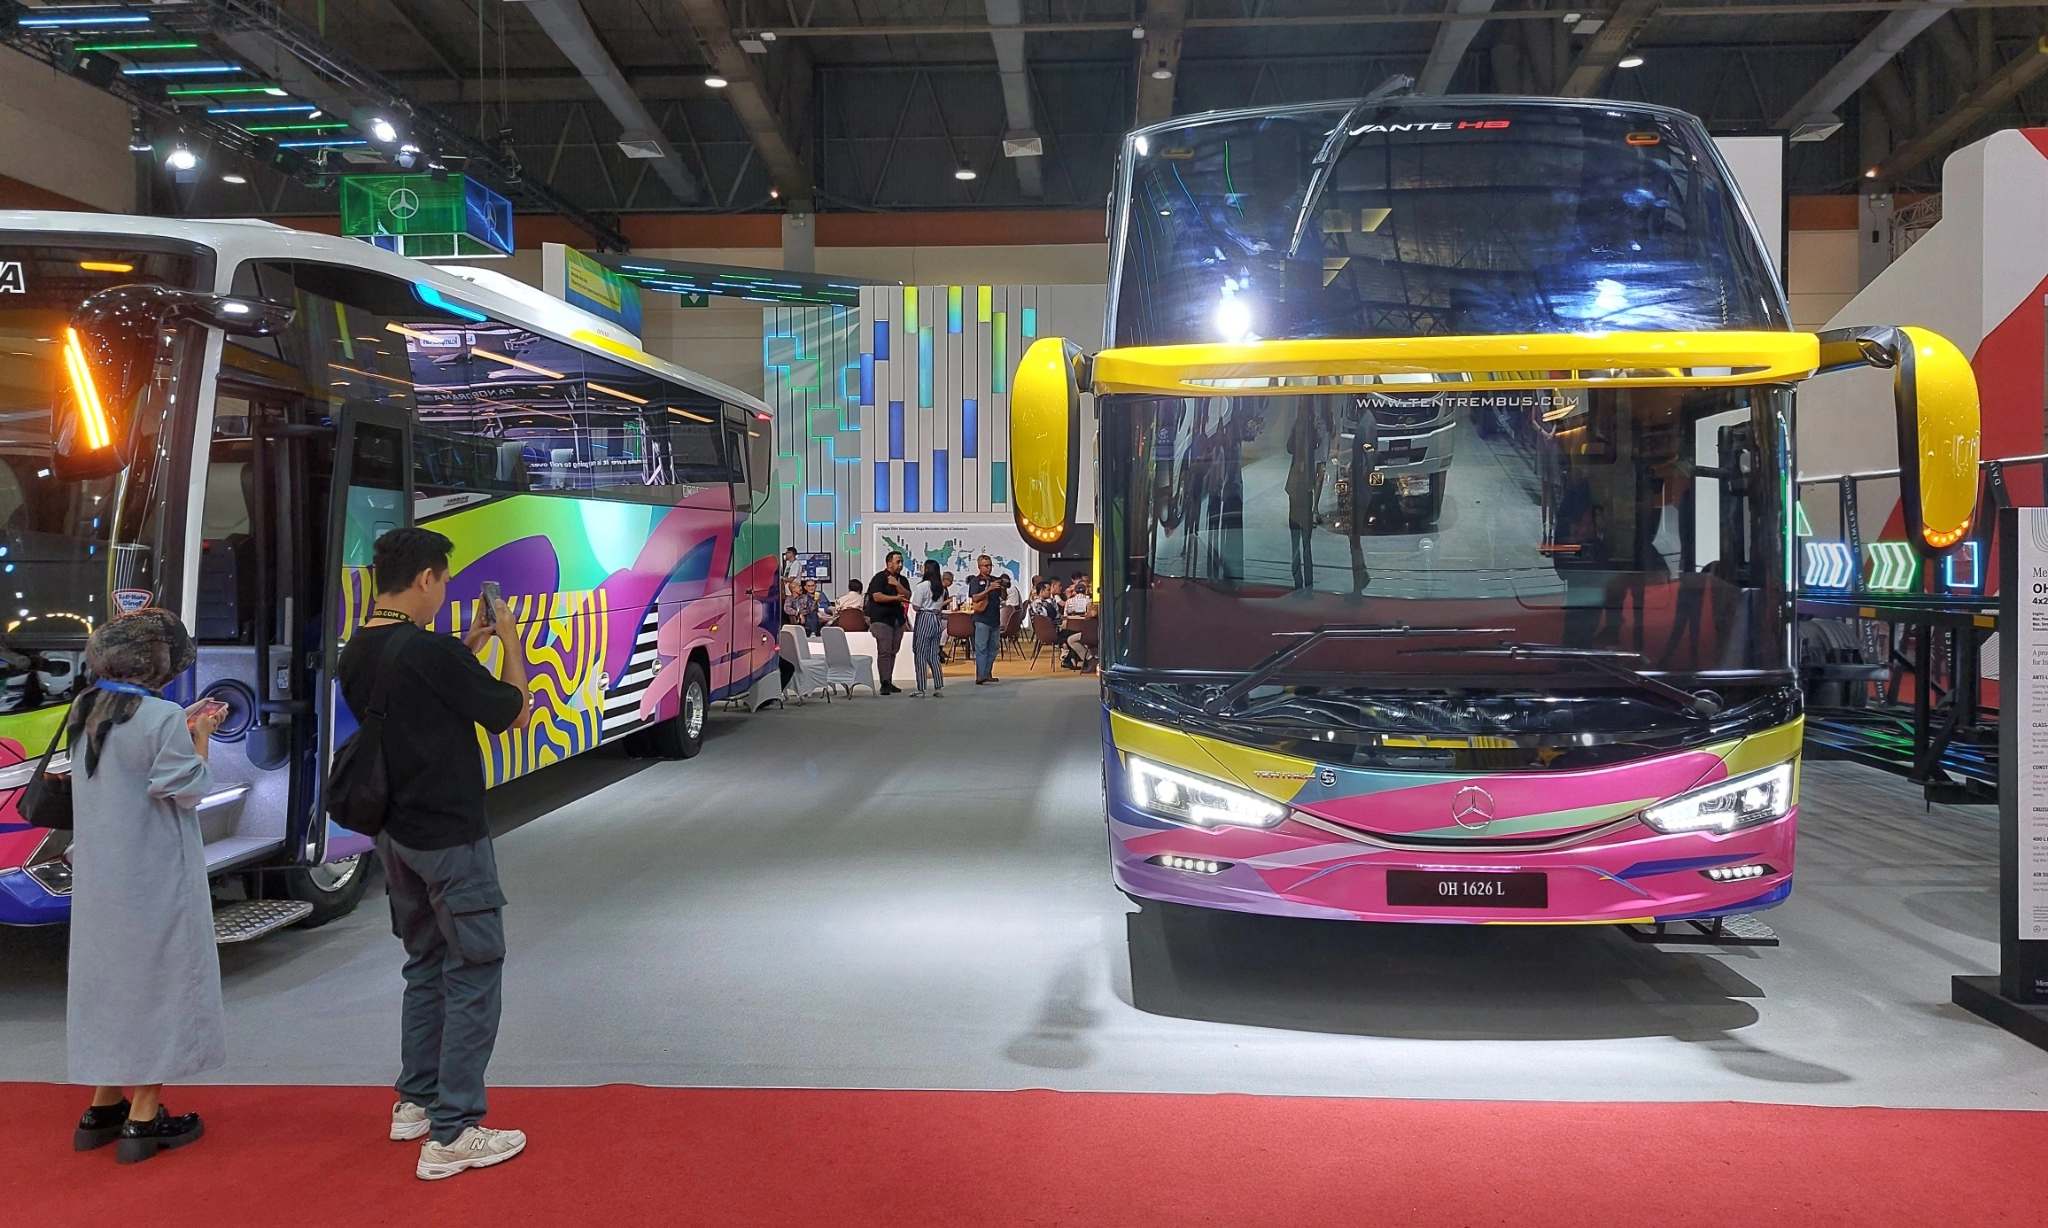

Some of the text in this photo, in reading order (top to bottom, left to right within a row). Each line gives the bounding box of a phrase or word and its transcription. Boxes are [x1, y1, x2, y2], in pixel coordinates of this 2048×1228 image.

[0, 261, 26, 294] A
[1356, 396, 1579, 408] WWW.TENTREMBUS.COM
[1438, 881, 1505, 896] OH 1626 L
[470, 1138, 486, 1151] N
